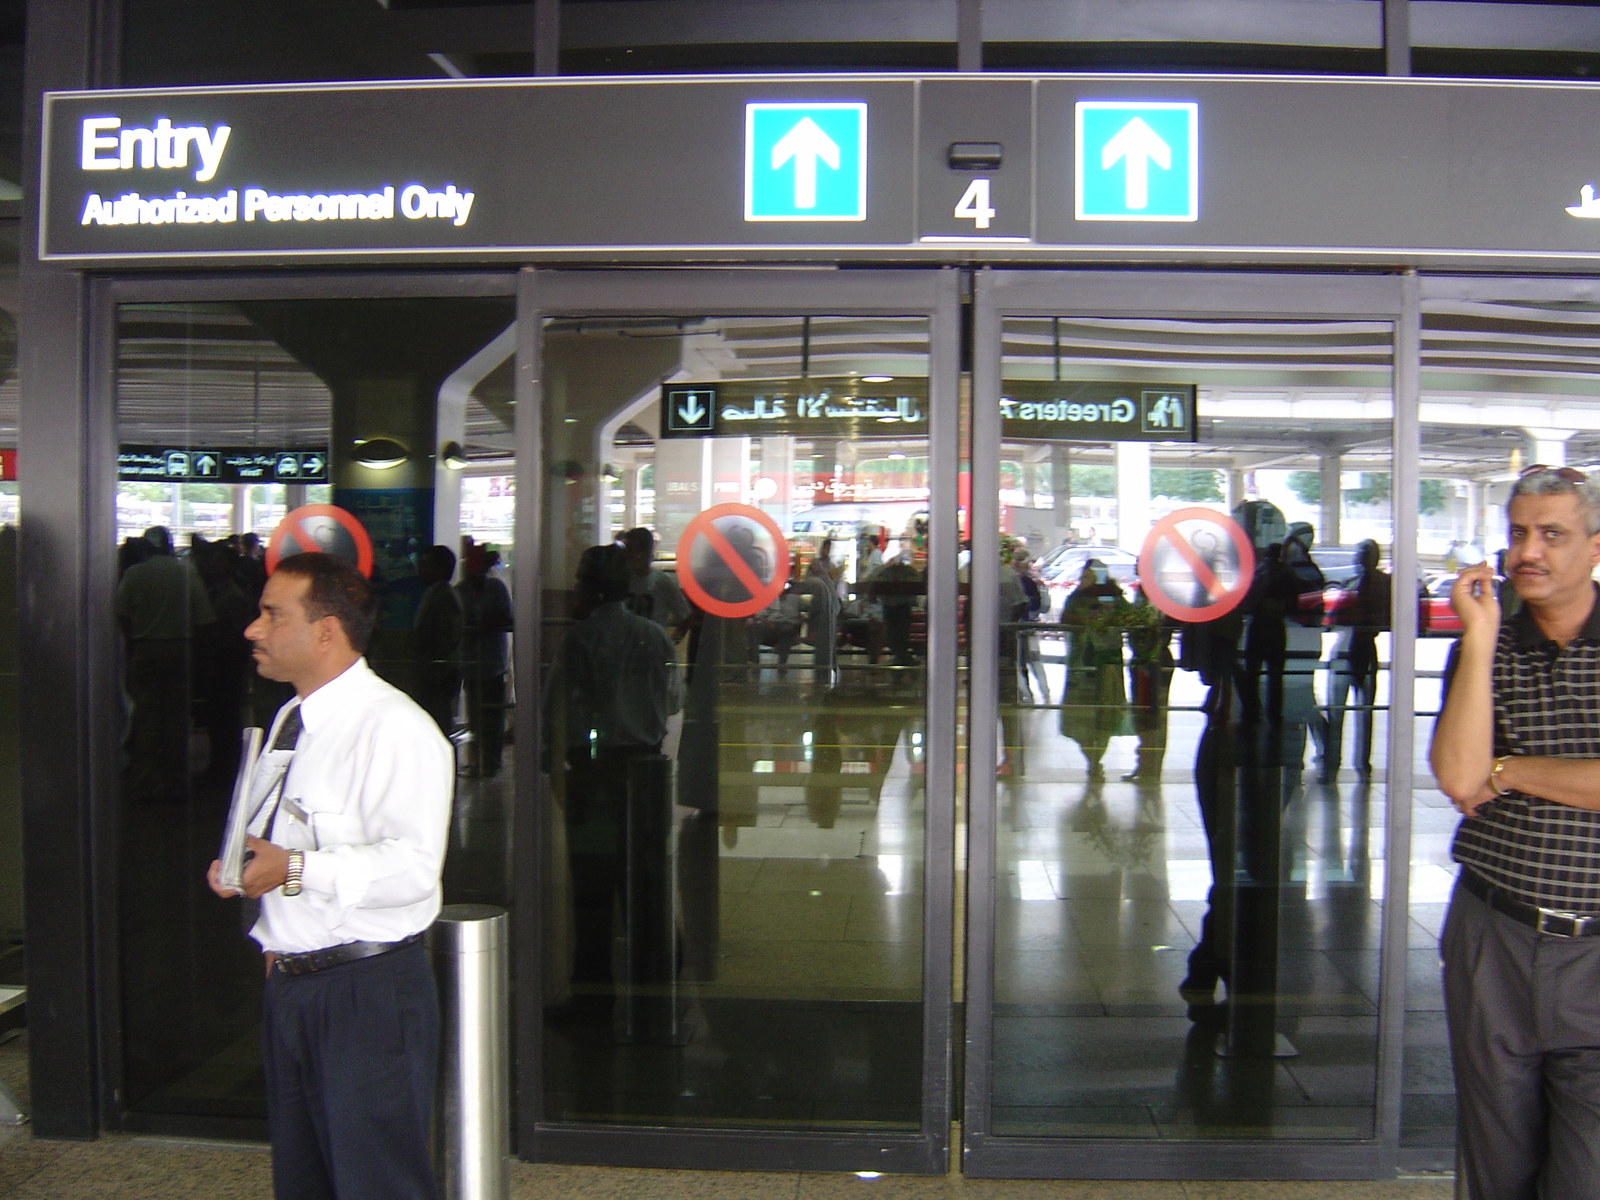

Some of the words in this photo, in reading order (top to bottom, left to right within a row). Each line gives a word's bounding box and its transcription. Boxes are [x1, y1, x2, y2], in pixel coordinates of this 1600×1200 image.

[81, 116, 232, 183] Entry
[81, 189, 239, 226] Authorized
[244, 186, 395, 222] Personnel
[400, 184, 476, 227] Only
[953, 178, 996, 230] 4
